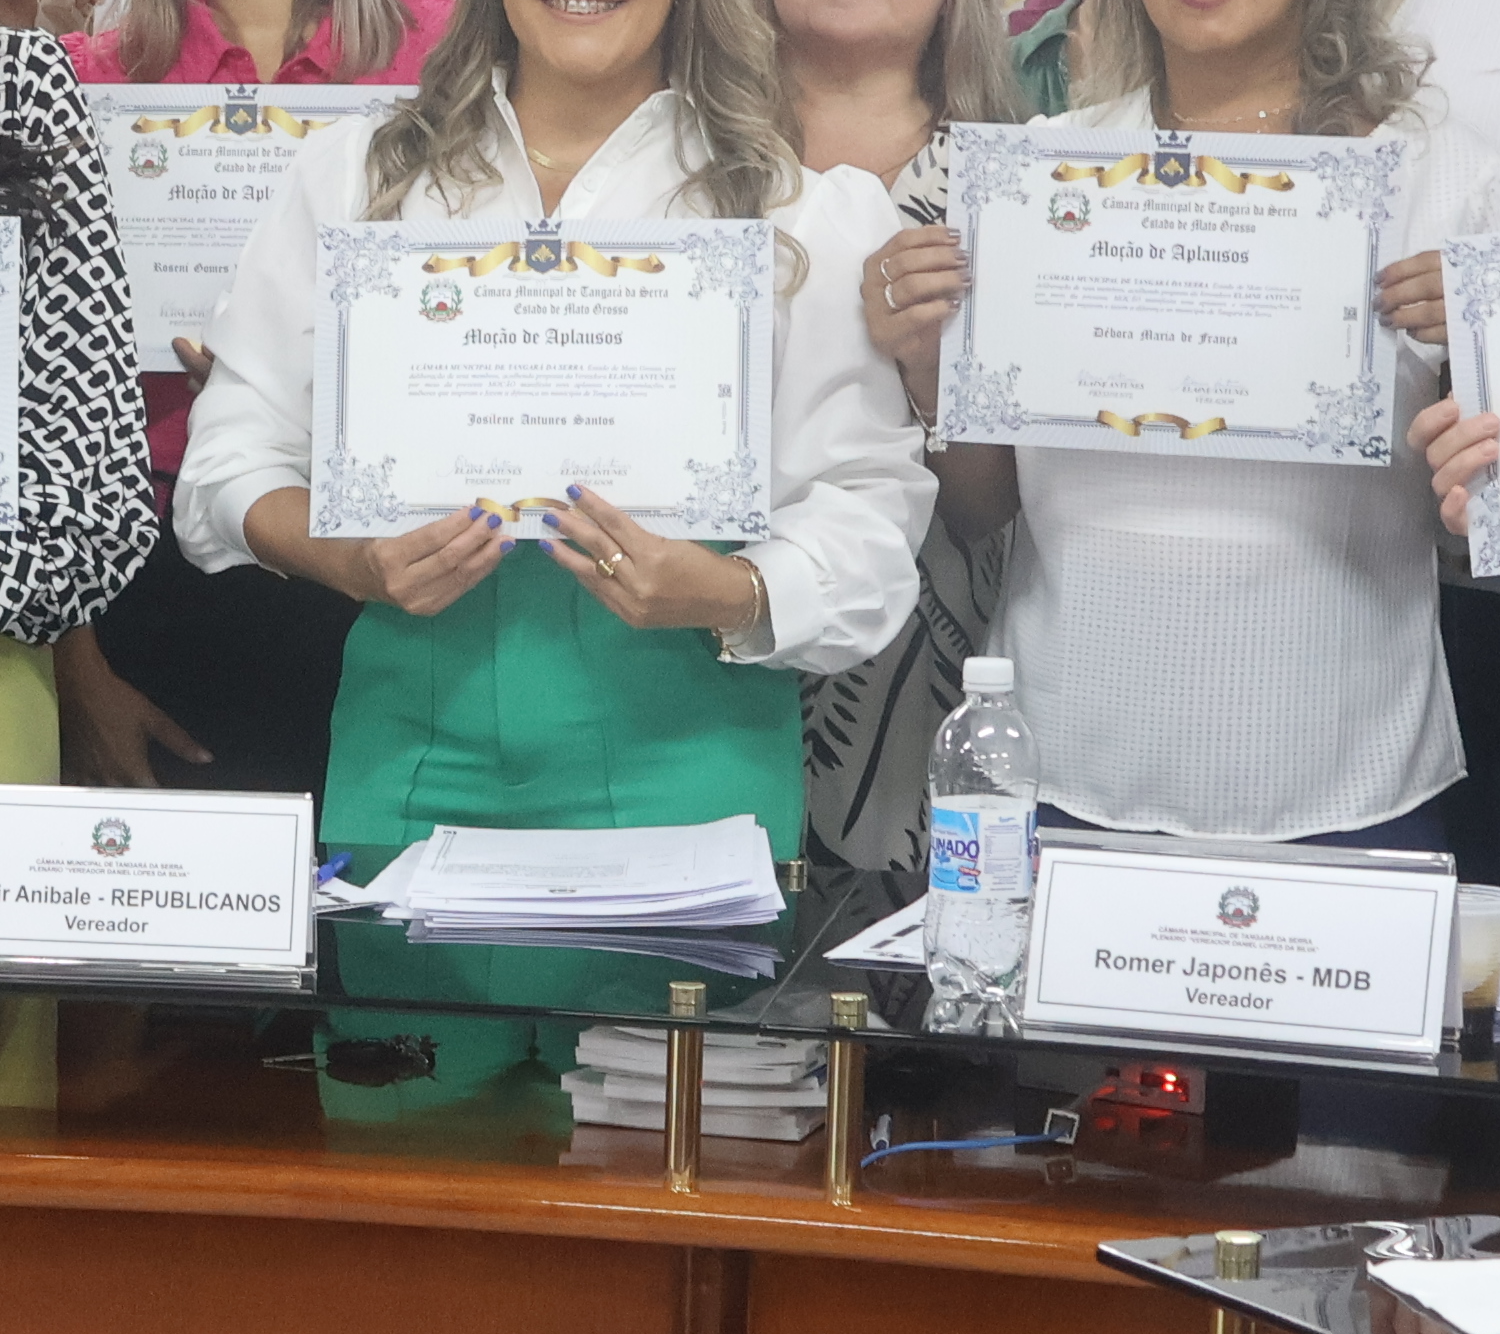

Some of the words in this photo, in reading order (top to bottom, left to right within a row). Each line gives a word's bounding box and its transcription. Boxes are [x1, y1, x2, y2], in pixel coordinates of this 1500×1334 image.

[168, 184, 216, 204] Moção
[222, 185, 237, 200] de
[1089, 241, 1144, 263] Moção
[1148, 243, 1166, 262] de
[1171, 244, 1250, 266] Aplausos
[153, 262, 189, 274] Roseni
[194, 263, 229, 274] Gomes
[473, 285, 512, 299] Câmara
[515, 285, 563, 300] Municipal
[566, 286, 577, 298] de
[580, 285, 622, 301] Tangará
[625, 286, 636, 298] da
[639, 286, 669, 299] Serra
[514, 303, 547, 316] Estado
[550, 303, 561, 315] de
[563, 302, 590, 317] Mato
[593, 303, 629, 316] Grosso
[462, 328, 517, 350] Moção
[522, 328, 540, 346] de
[545, 328, 623, 348] Aplausos
[1093, 326, 1134, 341] Débora
[1140, 329, 1175, 343] Maria
[1181, 331, 1193, 343] de
[1198, 331, 1238, 347] França
[467, 413, 514, 428] Josilene
[520, 413, 567, 426] Antunes
[573, 414, 615, 427] Santos
[15, 886, 91, 906] Anibale
[111, 888, 281, 913] REPUBLICANOS
[64, 915, 149, 934] Vereador
[1095, 948, 1175, 976] Romer
[1182, 956, 1287, 985] Japonês
[1312, 968, 1371, 992] MDB
[1185, 986, 1273, 1011] Vereador
